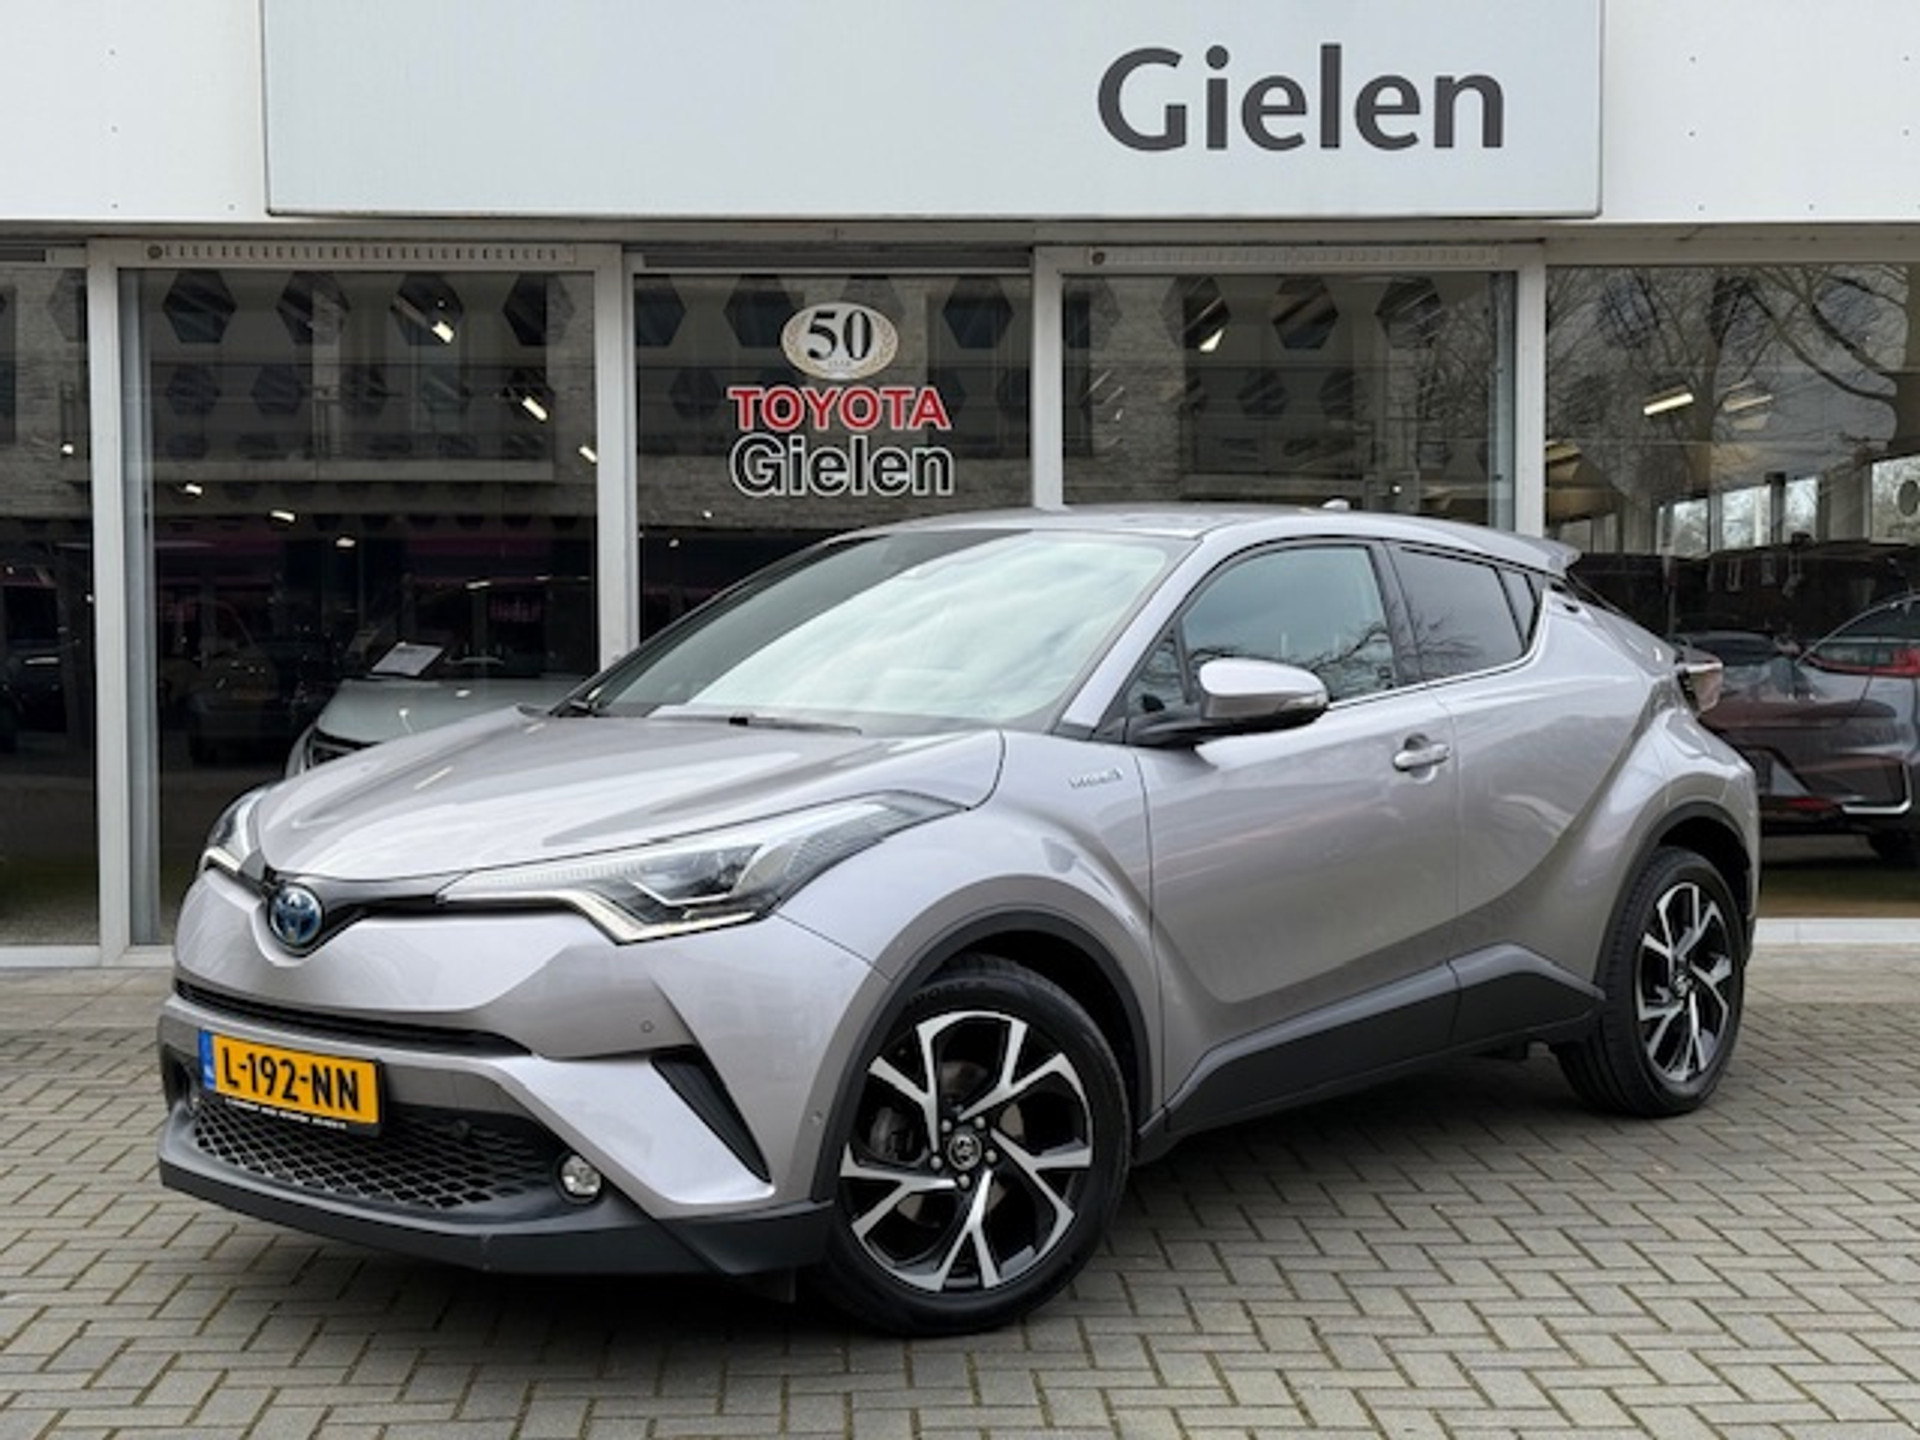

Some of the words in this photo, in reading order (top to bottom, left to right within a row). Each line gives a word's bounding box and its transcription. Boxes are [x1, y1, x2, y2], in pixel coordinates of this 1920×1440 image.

[1097, 43, 1504, 152] Gielen
[806, 310, 873, 361] 50
[728, 386, 951, 431] TOYOTA
[730, 432, 953, 496] Gielen
[222, 1047, 359, 1112] L-192-NN
